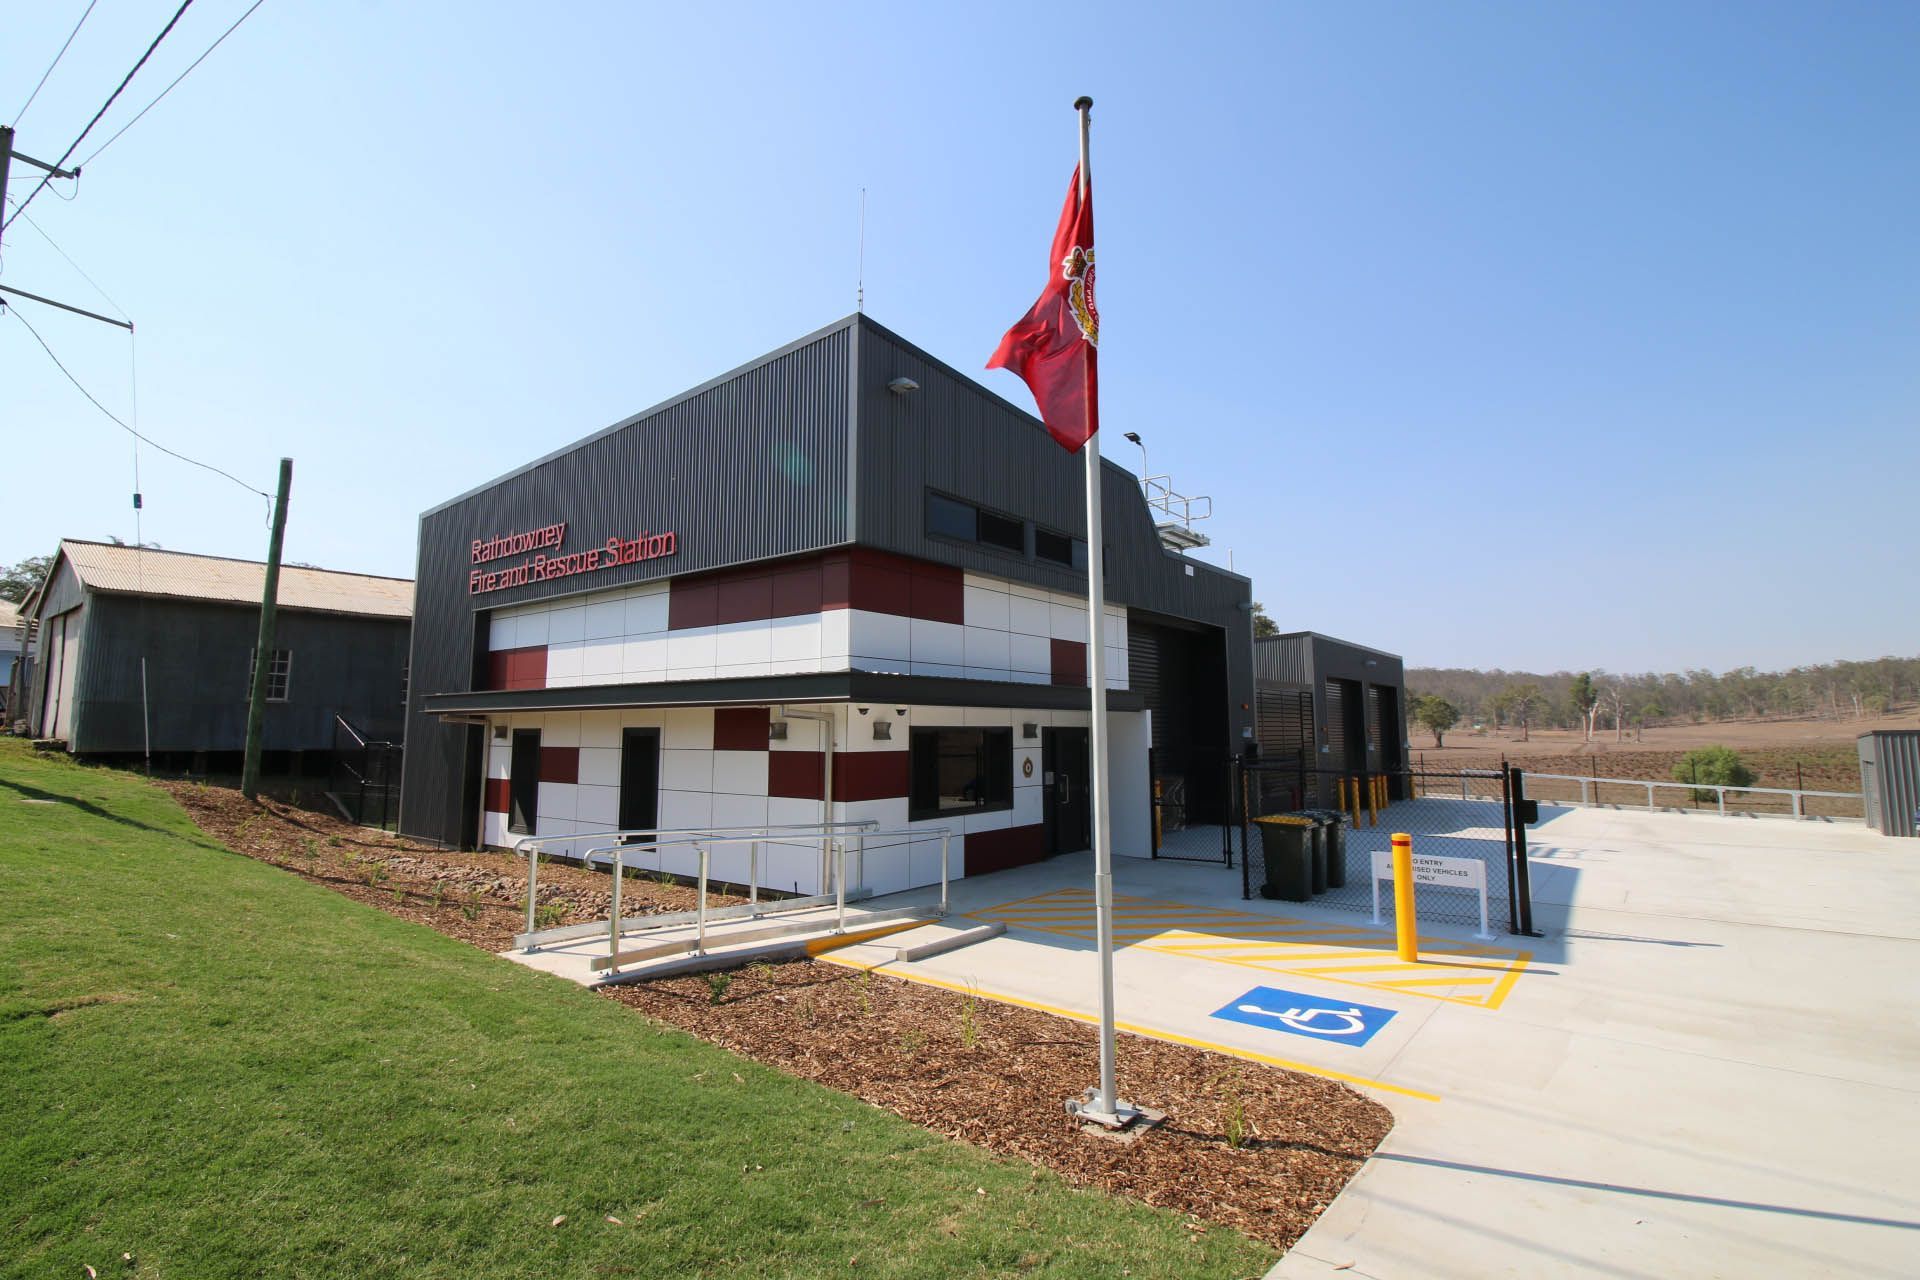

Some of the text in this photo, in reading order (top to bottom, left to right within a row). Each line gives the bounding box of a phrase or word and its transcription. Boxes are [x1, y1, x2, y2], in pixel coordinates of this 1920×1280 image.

[469, 529, 676, 595] Fire and Rescue Station
[471, 522, 566, 565] Rathdowney
[1432, 868, 1468, 876] VEHICLES
